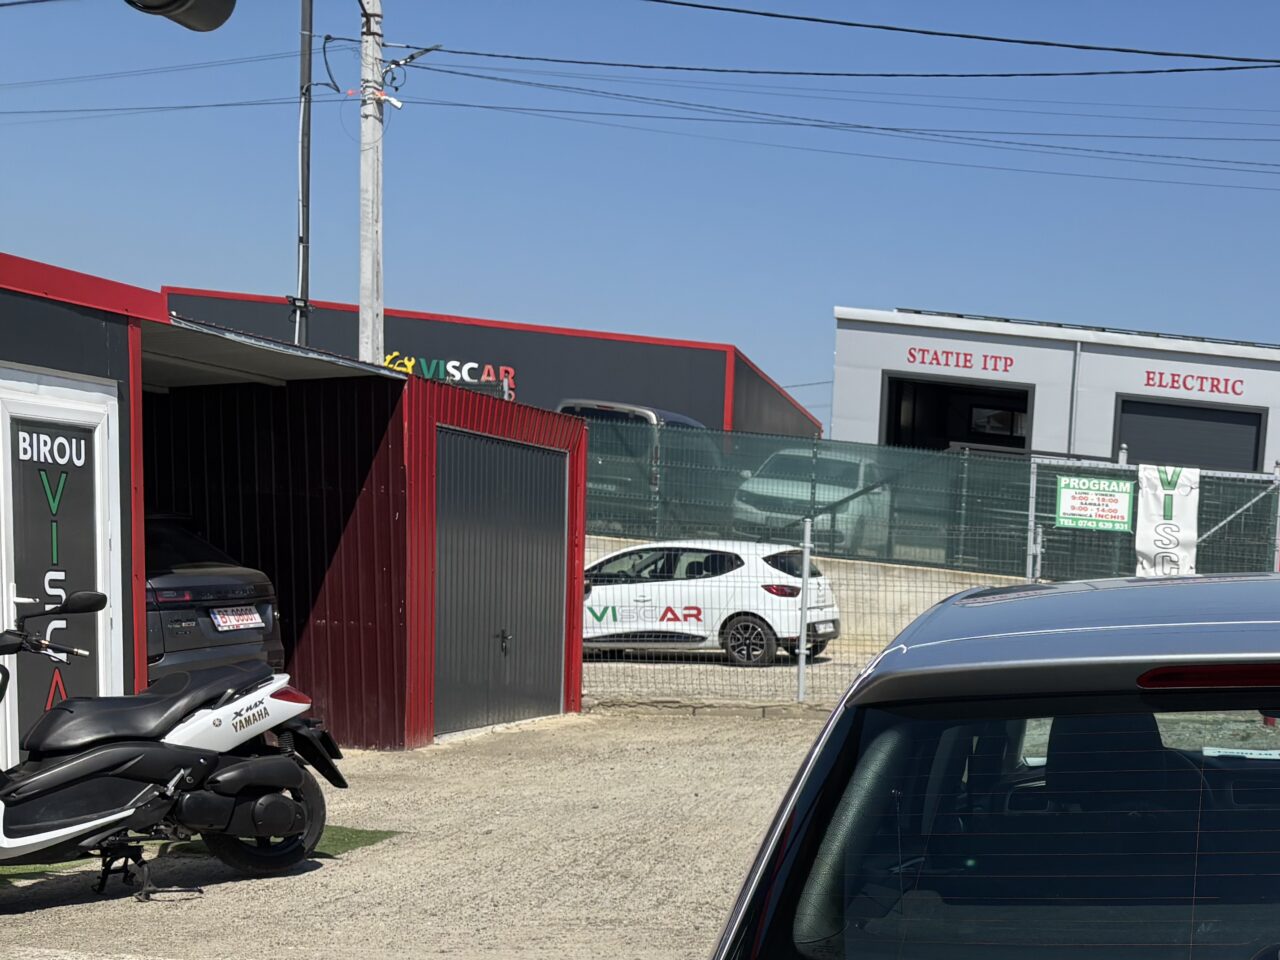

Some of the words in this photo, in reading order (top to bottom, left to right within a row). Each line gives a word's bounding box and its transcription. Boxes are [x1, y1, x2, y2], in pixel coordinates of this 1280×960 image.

[419, 358, 516, 388] VISCAR
[907, 347, 973, 369] STATIE
[982, 354, 1014, 373] ITP
[1144, 370, 1244, 396] ELECTRIC
[18, 431, 86, 467] BIROU
[1060, 477, 1131, 493] PROGRAM
[587, 606, 703, 622] VISCAR
[232, 706, 270, 733] YAMAHA
